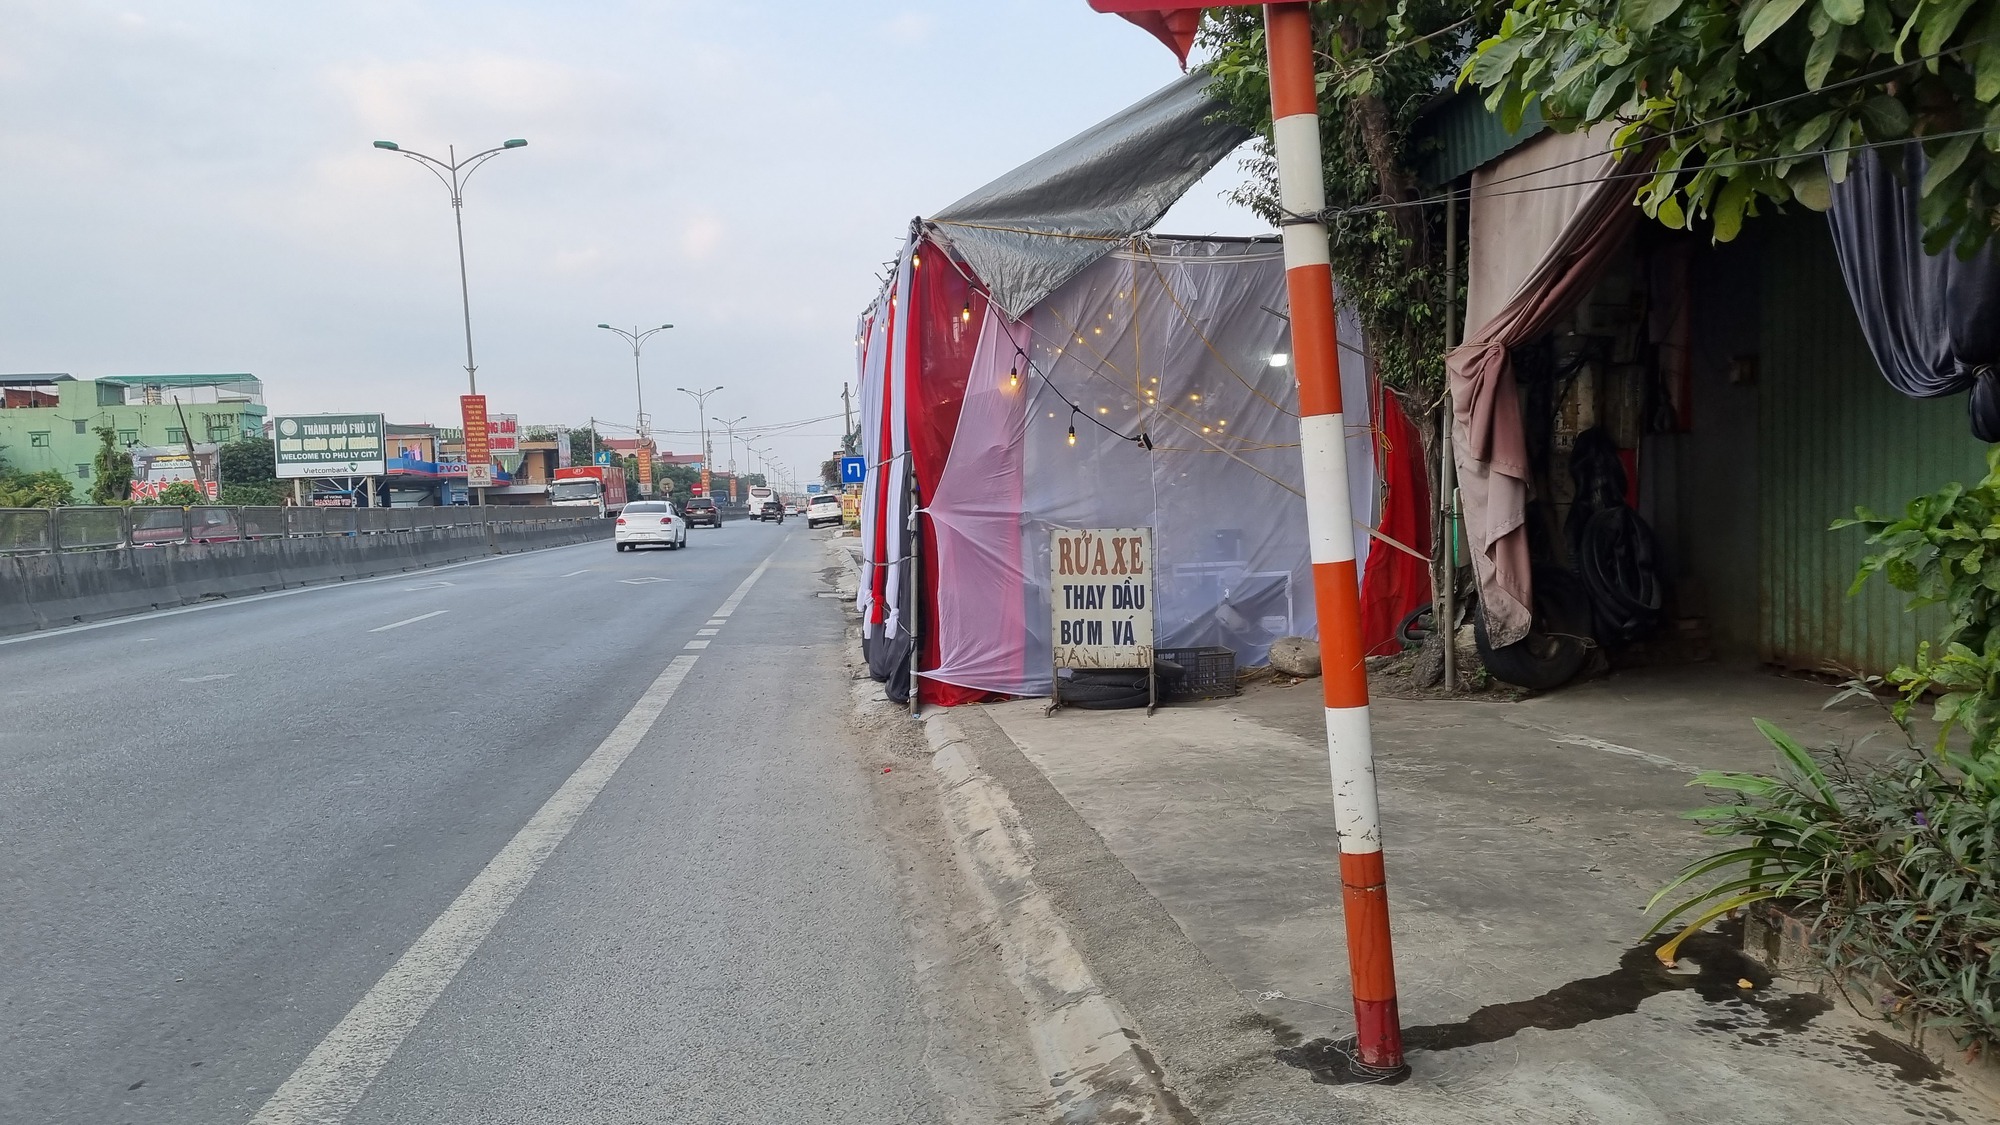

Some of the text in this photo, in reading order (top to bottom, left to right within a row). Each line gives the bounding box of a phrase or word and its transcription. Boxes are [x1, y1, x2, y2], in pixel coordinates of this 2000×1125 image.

[303, 423, 329, 435] THÀNH
[367, 422, 376, 433] LÝ
[440, 426, 462, 439] KHÁ
[487, 422, 498, 434] NG
[1058, 530, 1144, 576] RỬA XE
[1063, 576, 1145, 610] THAY DẦU
[1060, 615, 1135, 646] BƠM VÁ
